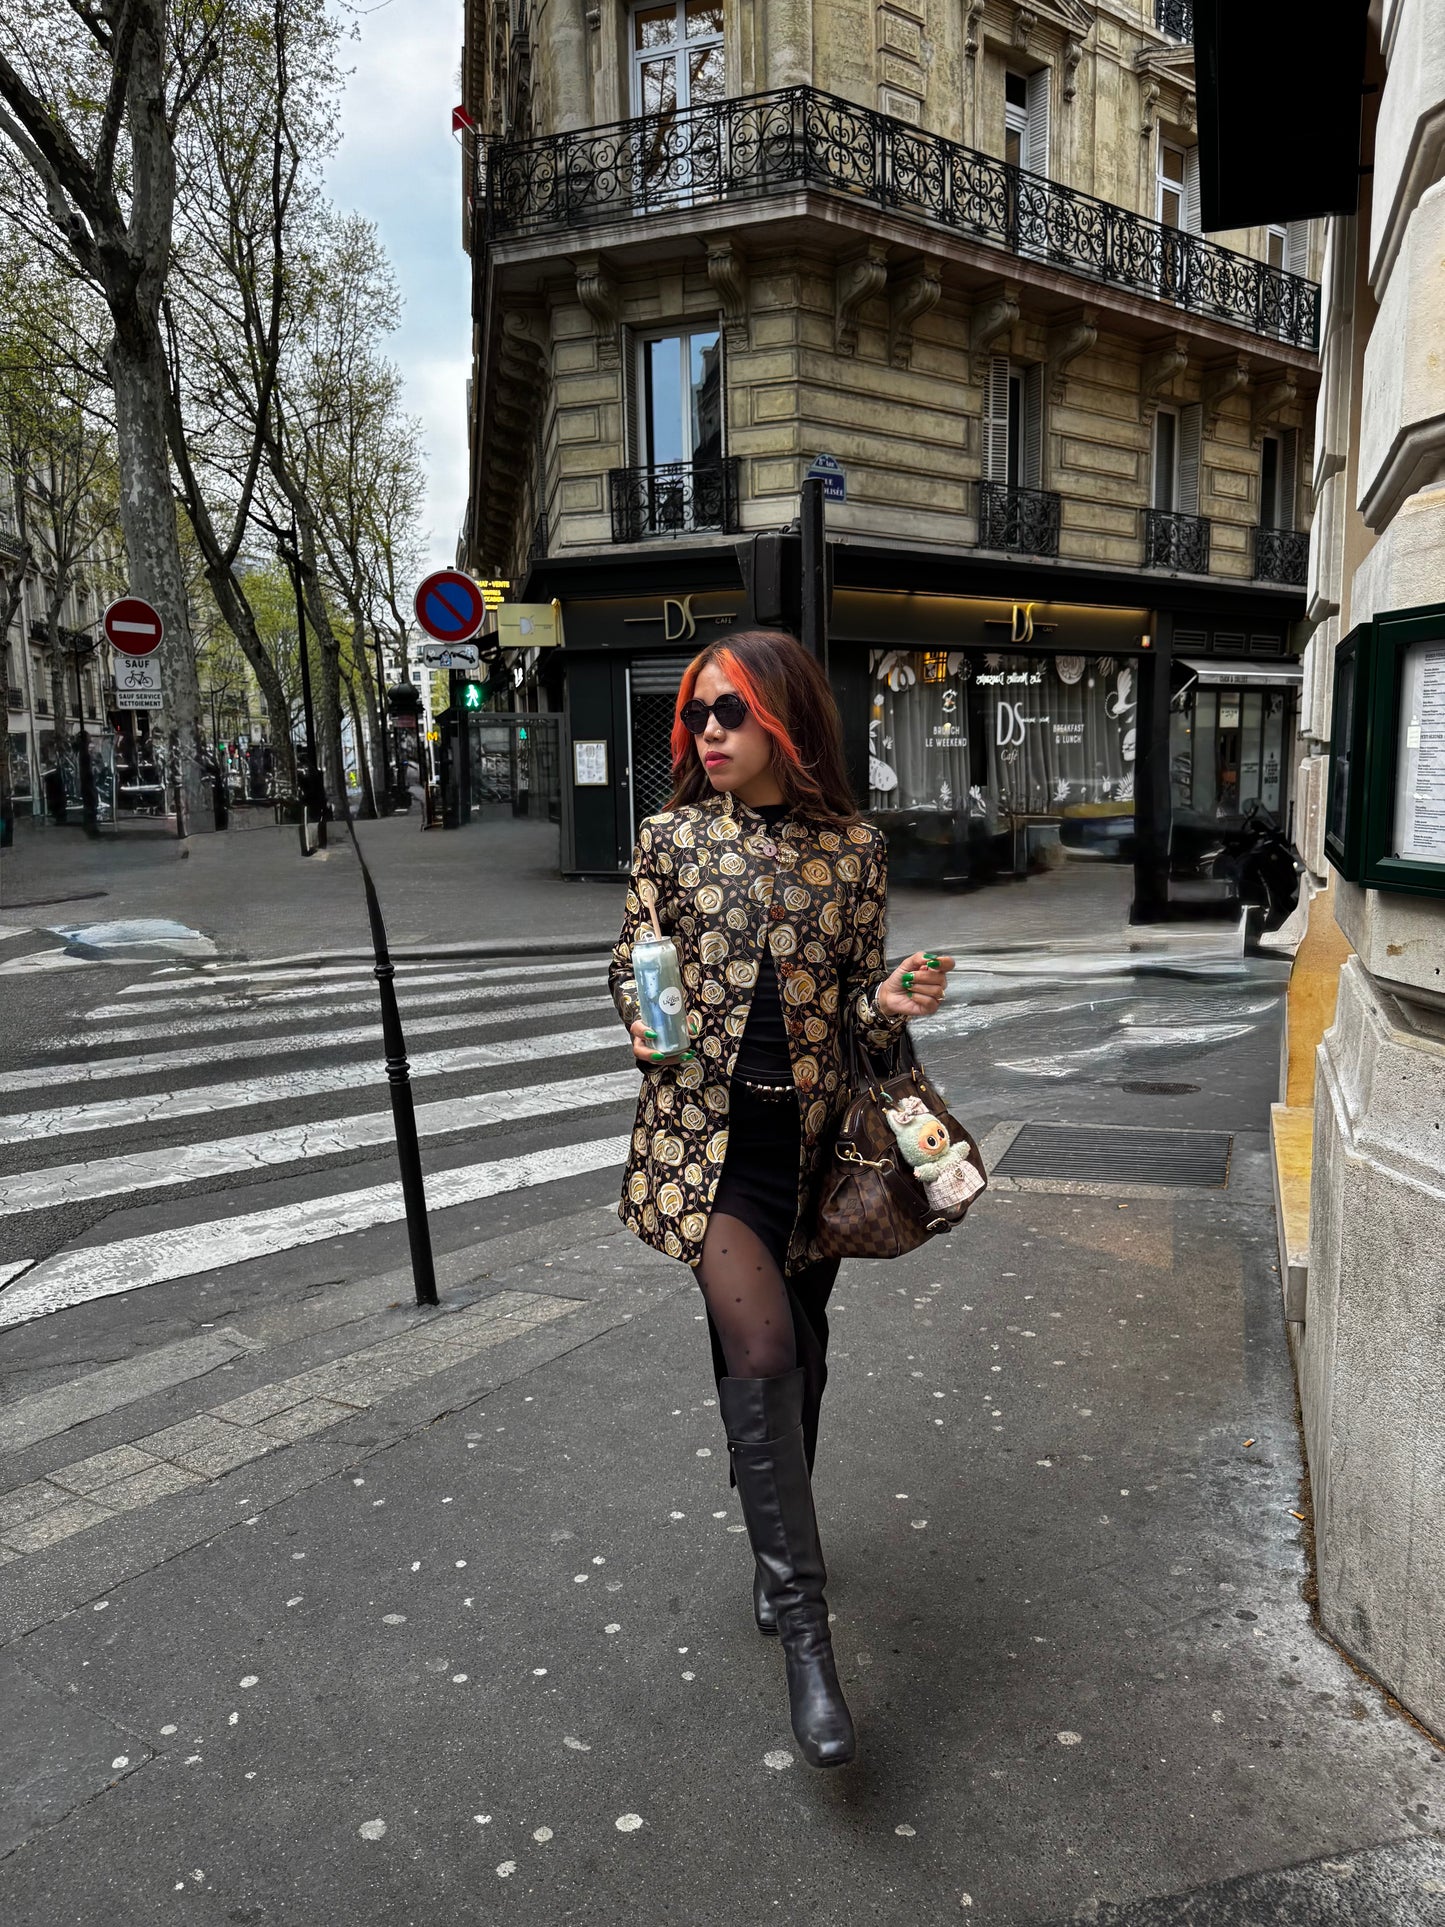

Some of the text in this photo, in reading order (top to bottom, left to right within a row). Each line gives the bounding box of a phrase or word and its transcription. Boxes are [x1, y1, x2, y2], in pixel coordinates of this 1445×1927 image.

[824, 487, 844, 496] LISÉE
[491, 580, 510, 588] VENTE
[664, 593, 696, 641] DS
[1011, 602, 1036, 642] DS
[125, 659, 150, 668] SAUF
[996, 701, 1025, 746] DS
[1053, 723, 1084, 733] BREAKFAST
[925, 737, 968, 748] LE WEEKEND
[1062, 735, 1082, 744] LUNCH
[1000, 748, 1019, 765] Café
